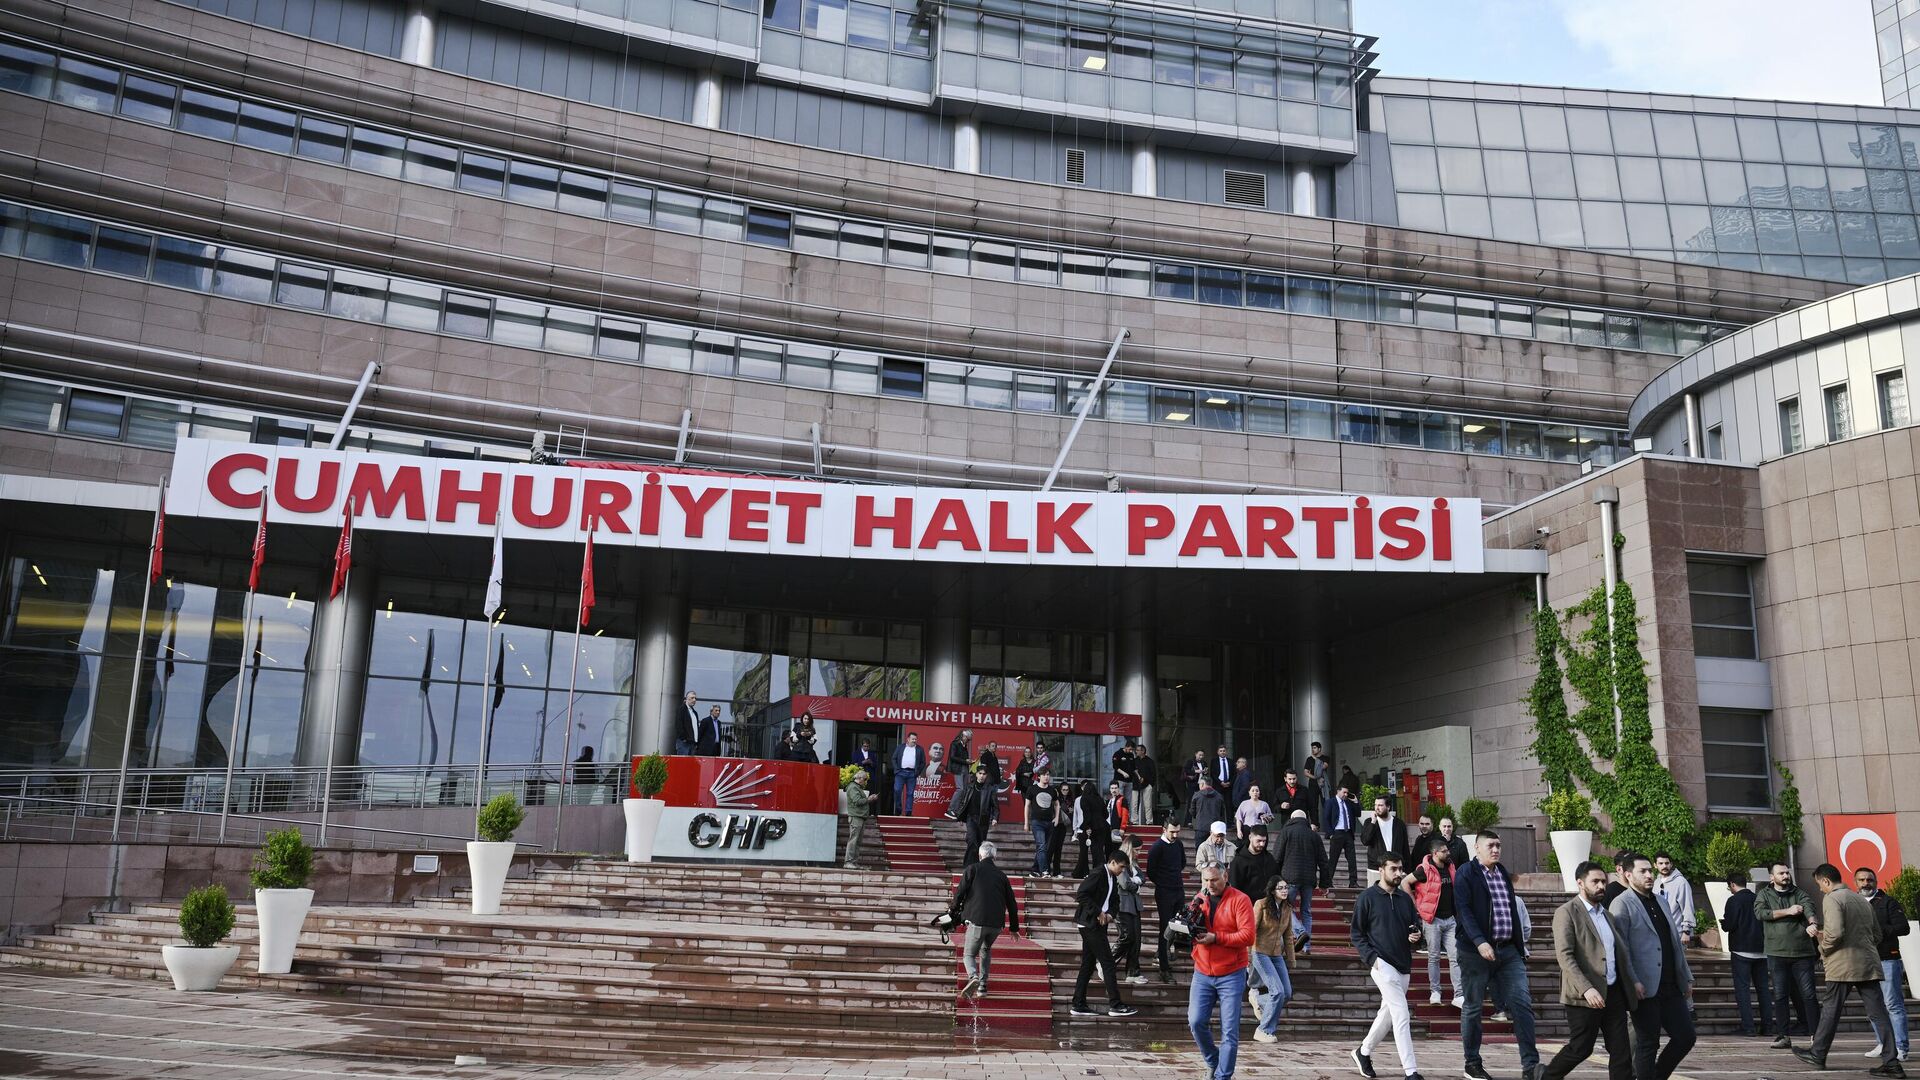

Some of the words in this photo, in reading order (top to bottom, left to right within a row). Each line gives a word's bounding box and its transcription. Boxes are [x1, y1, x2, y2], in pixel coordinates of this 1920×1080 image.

[207, 453, 822, 544] CUMHURİYET
[853, 495, 1093, 554] HALK
[1127, 496, 1452, 561] PARTİSİ
[866, 706, 967, 723] CUMHURİYET
[972, 712, 1012, 726] HALK
[1017, 713, 1075, 729] PARTİSİ
[688, 812, 788, 850] CHP
